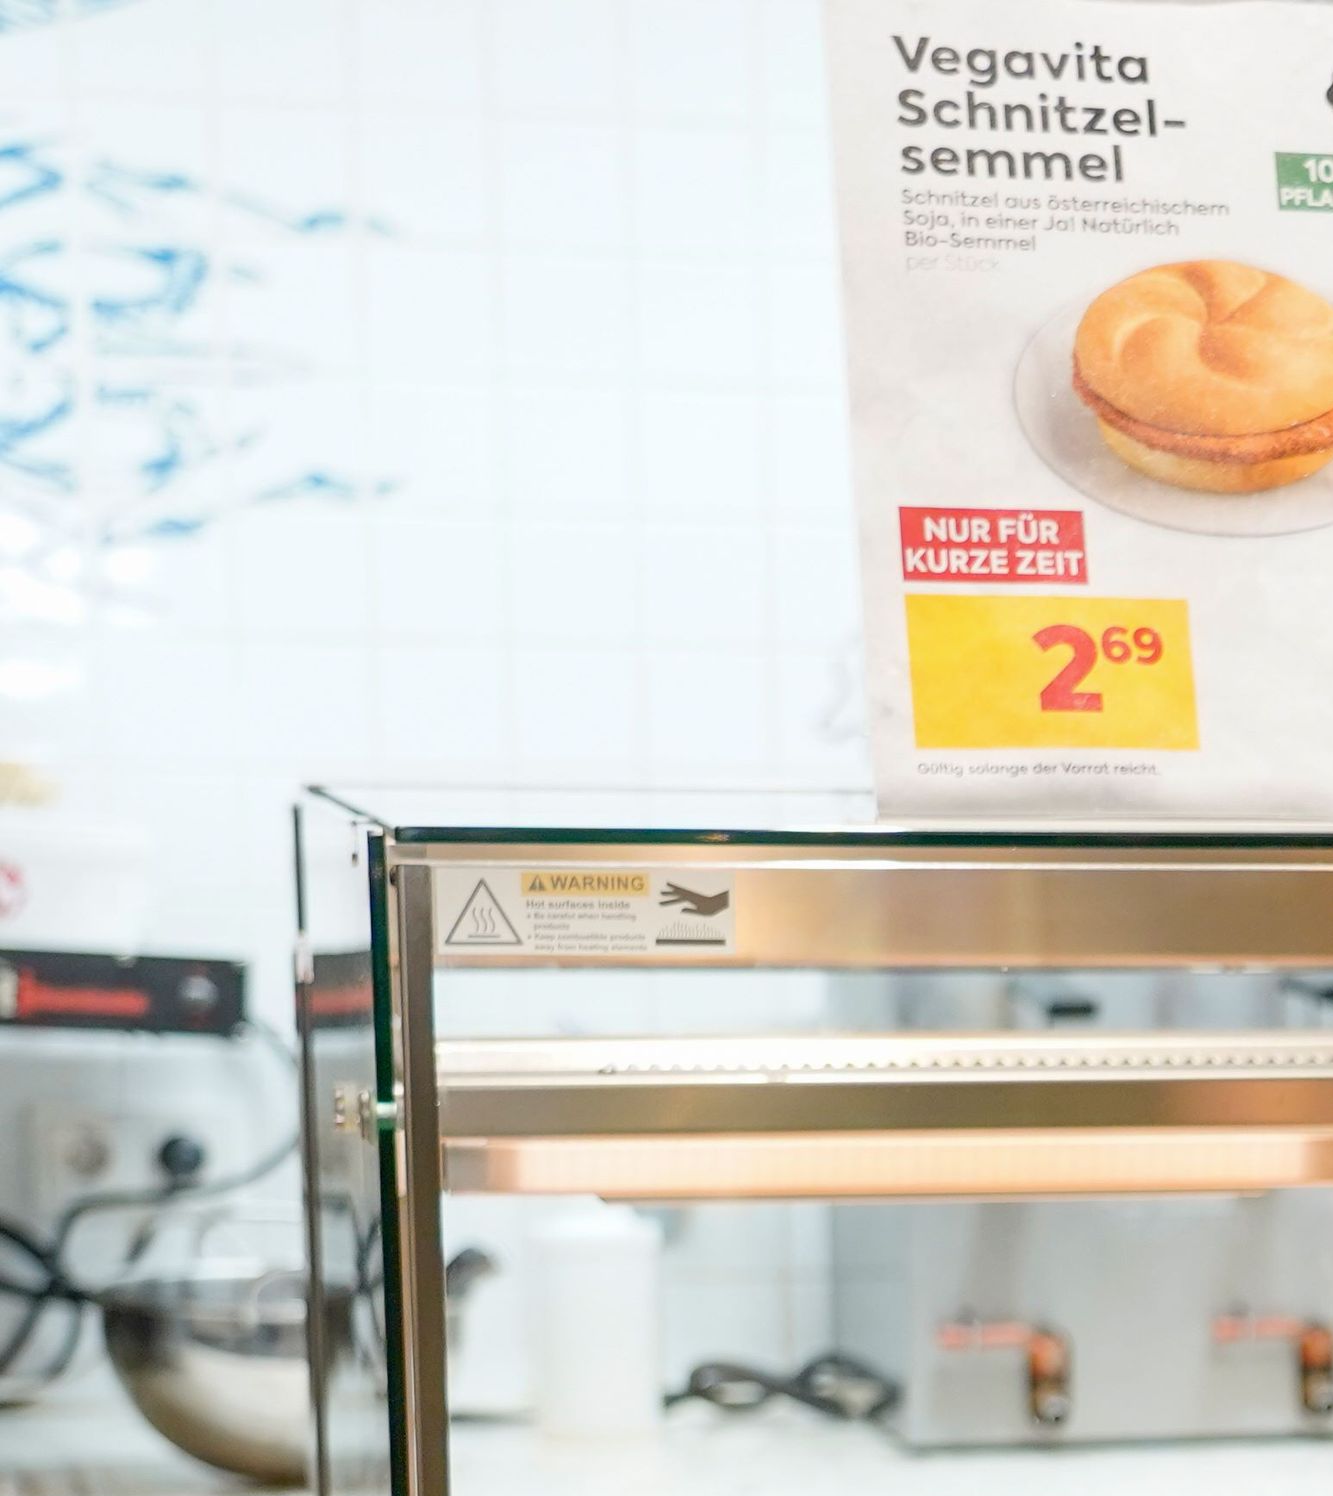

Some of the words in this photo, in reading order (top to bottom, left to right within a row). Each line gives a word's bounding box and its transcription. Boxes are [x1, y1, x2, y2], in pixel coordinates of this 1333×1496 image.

[891, 35, 1150, 87] Vegavita
[897, 88, 1187, 137] Schnitzel-
[901, 144, 1124, 182] semmel
[901, 188, 999, 208] Schnitzel
[1005, 196, 1041, 210] aus
[1047, 195, 1230, 216] österreichischem
[903, 209, 955, 231] Soja,
[961, 212, 980, 229] in
[985, 214, 1038, 230] einer
[1082, 217, 1180, 237] Natürlich
[904, 230, 1037, 251] Bio-Semmel
[922, 515, 992, 544] NUR
[998, 512, 1061, 545] FÜR
[905, 547, 1009, 575] KURZE
[1015, 549, 1084, 576] ZEIT
[968, 762, 1029, 778] solange
[1032, 762, 1058, 775] der
[1061, 761, 1111, 776] Vorrat
[550, 875, 646, 892] WARNING
[526, 900, 545, 910] Hot
[547, 900, 595, 910] surfaces
[598, 900, 632, 910] inside
